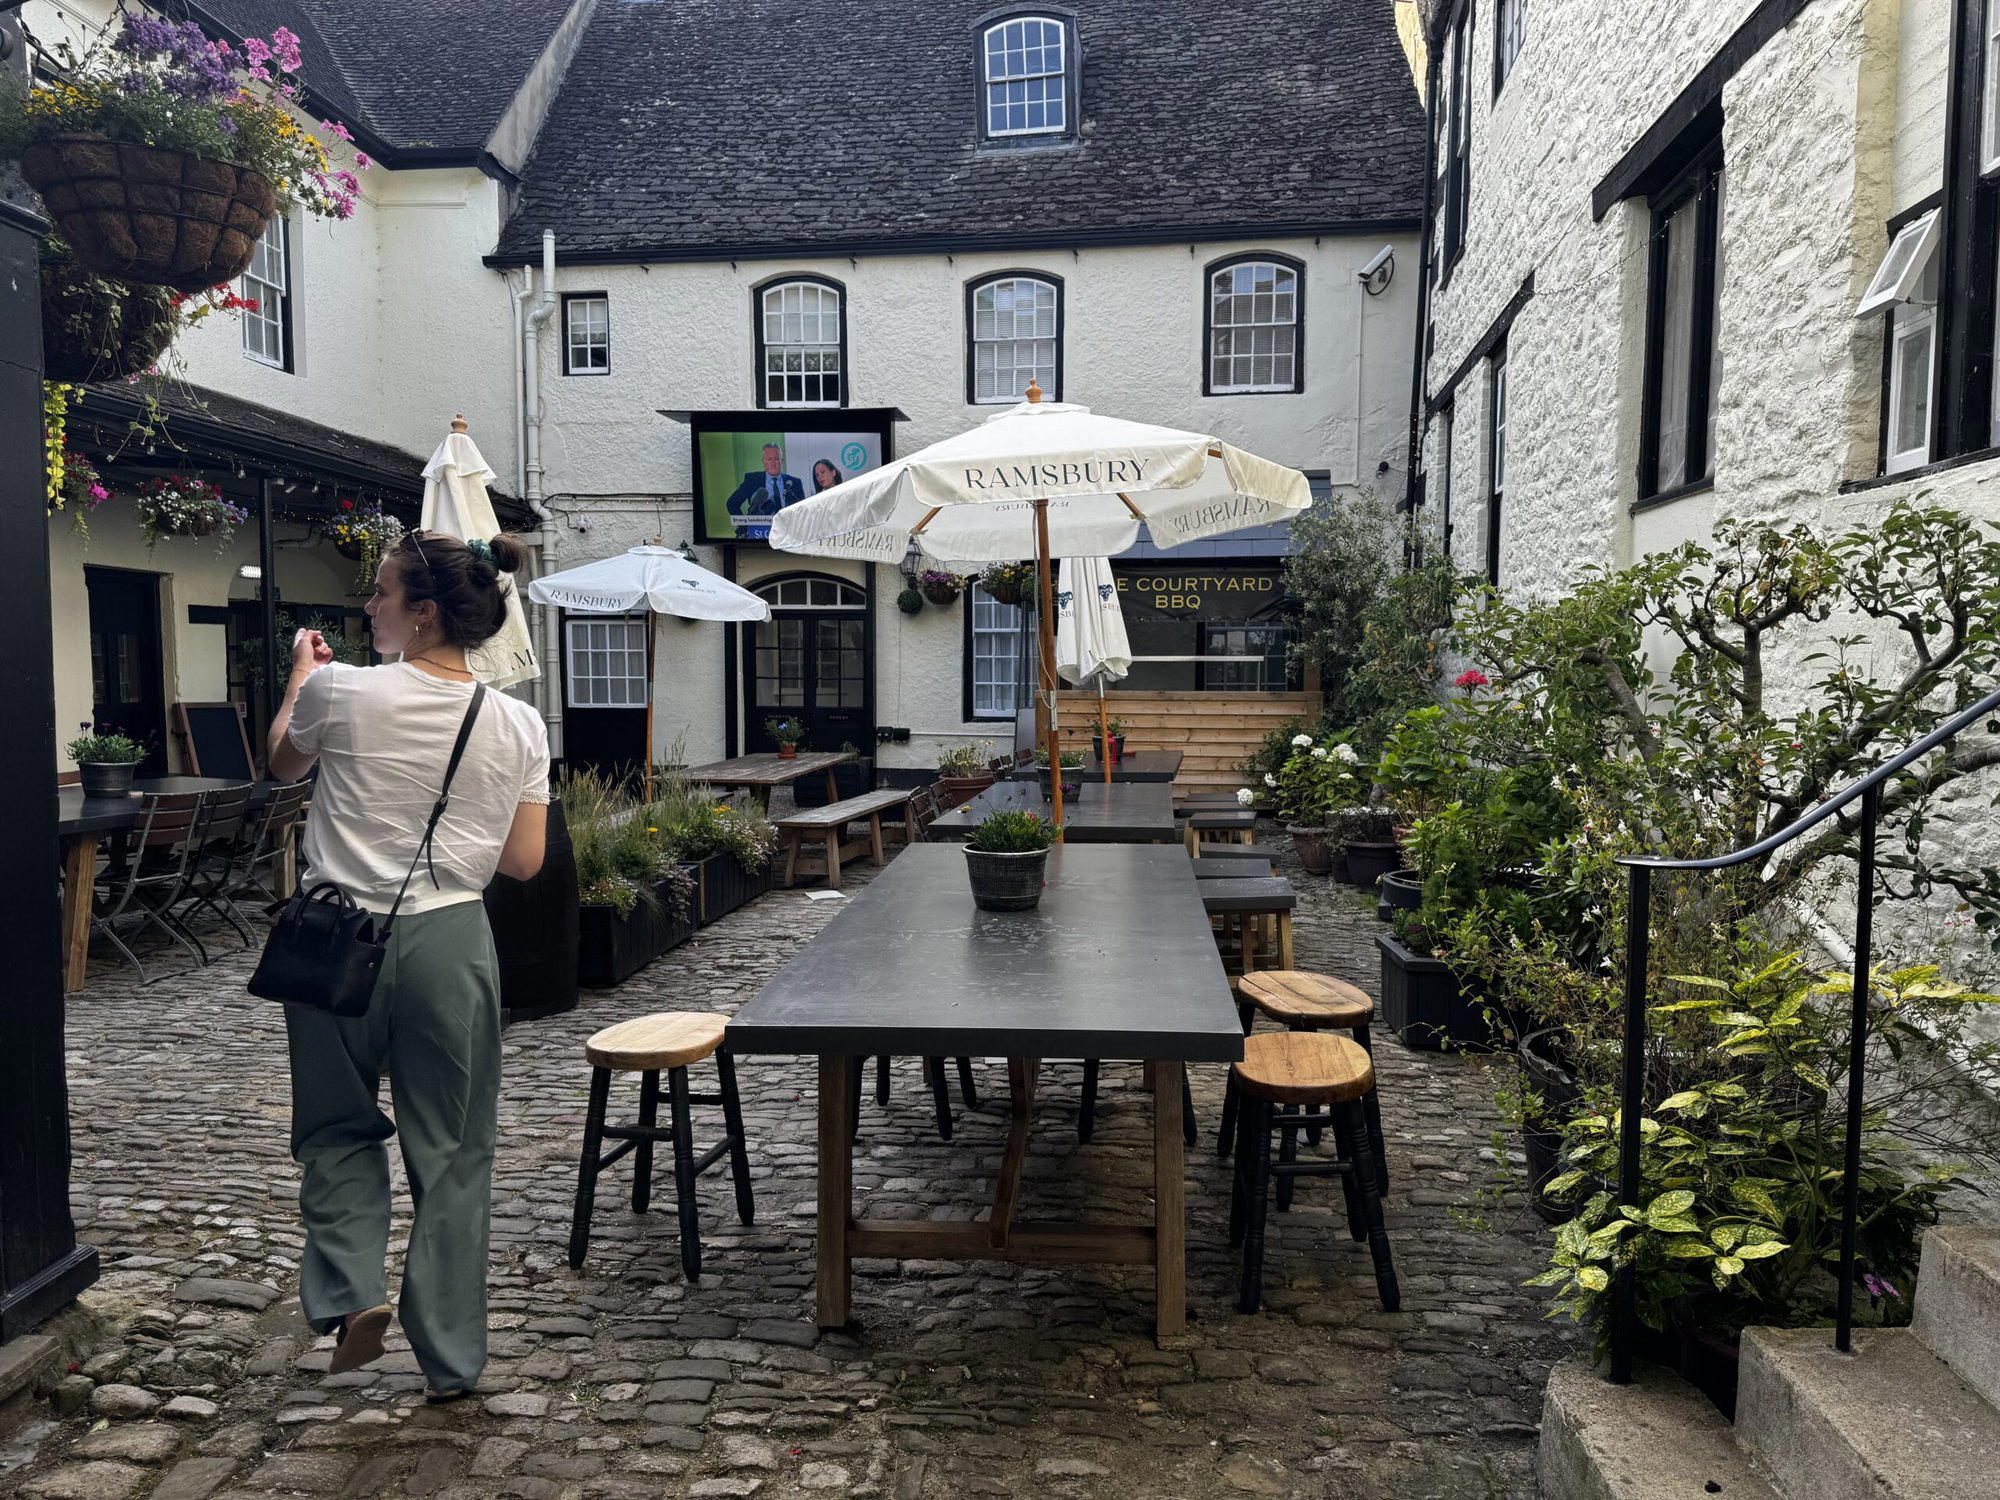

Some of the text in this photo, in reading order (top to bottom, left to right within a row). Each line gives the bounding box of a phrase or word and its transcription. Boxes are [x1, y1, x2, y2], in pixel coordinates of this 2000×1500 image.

[965, 458, 1149, 489] RAMSBURY
[1136, 577, 1273, 592] COURTYARD
[550, 589, 625, 608] RAMSBURY
[1155, 595, 1201, 610] BBQ
